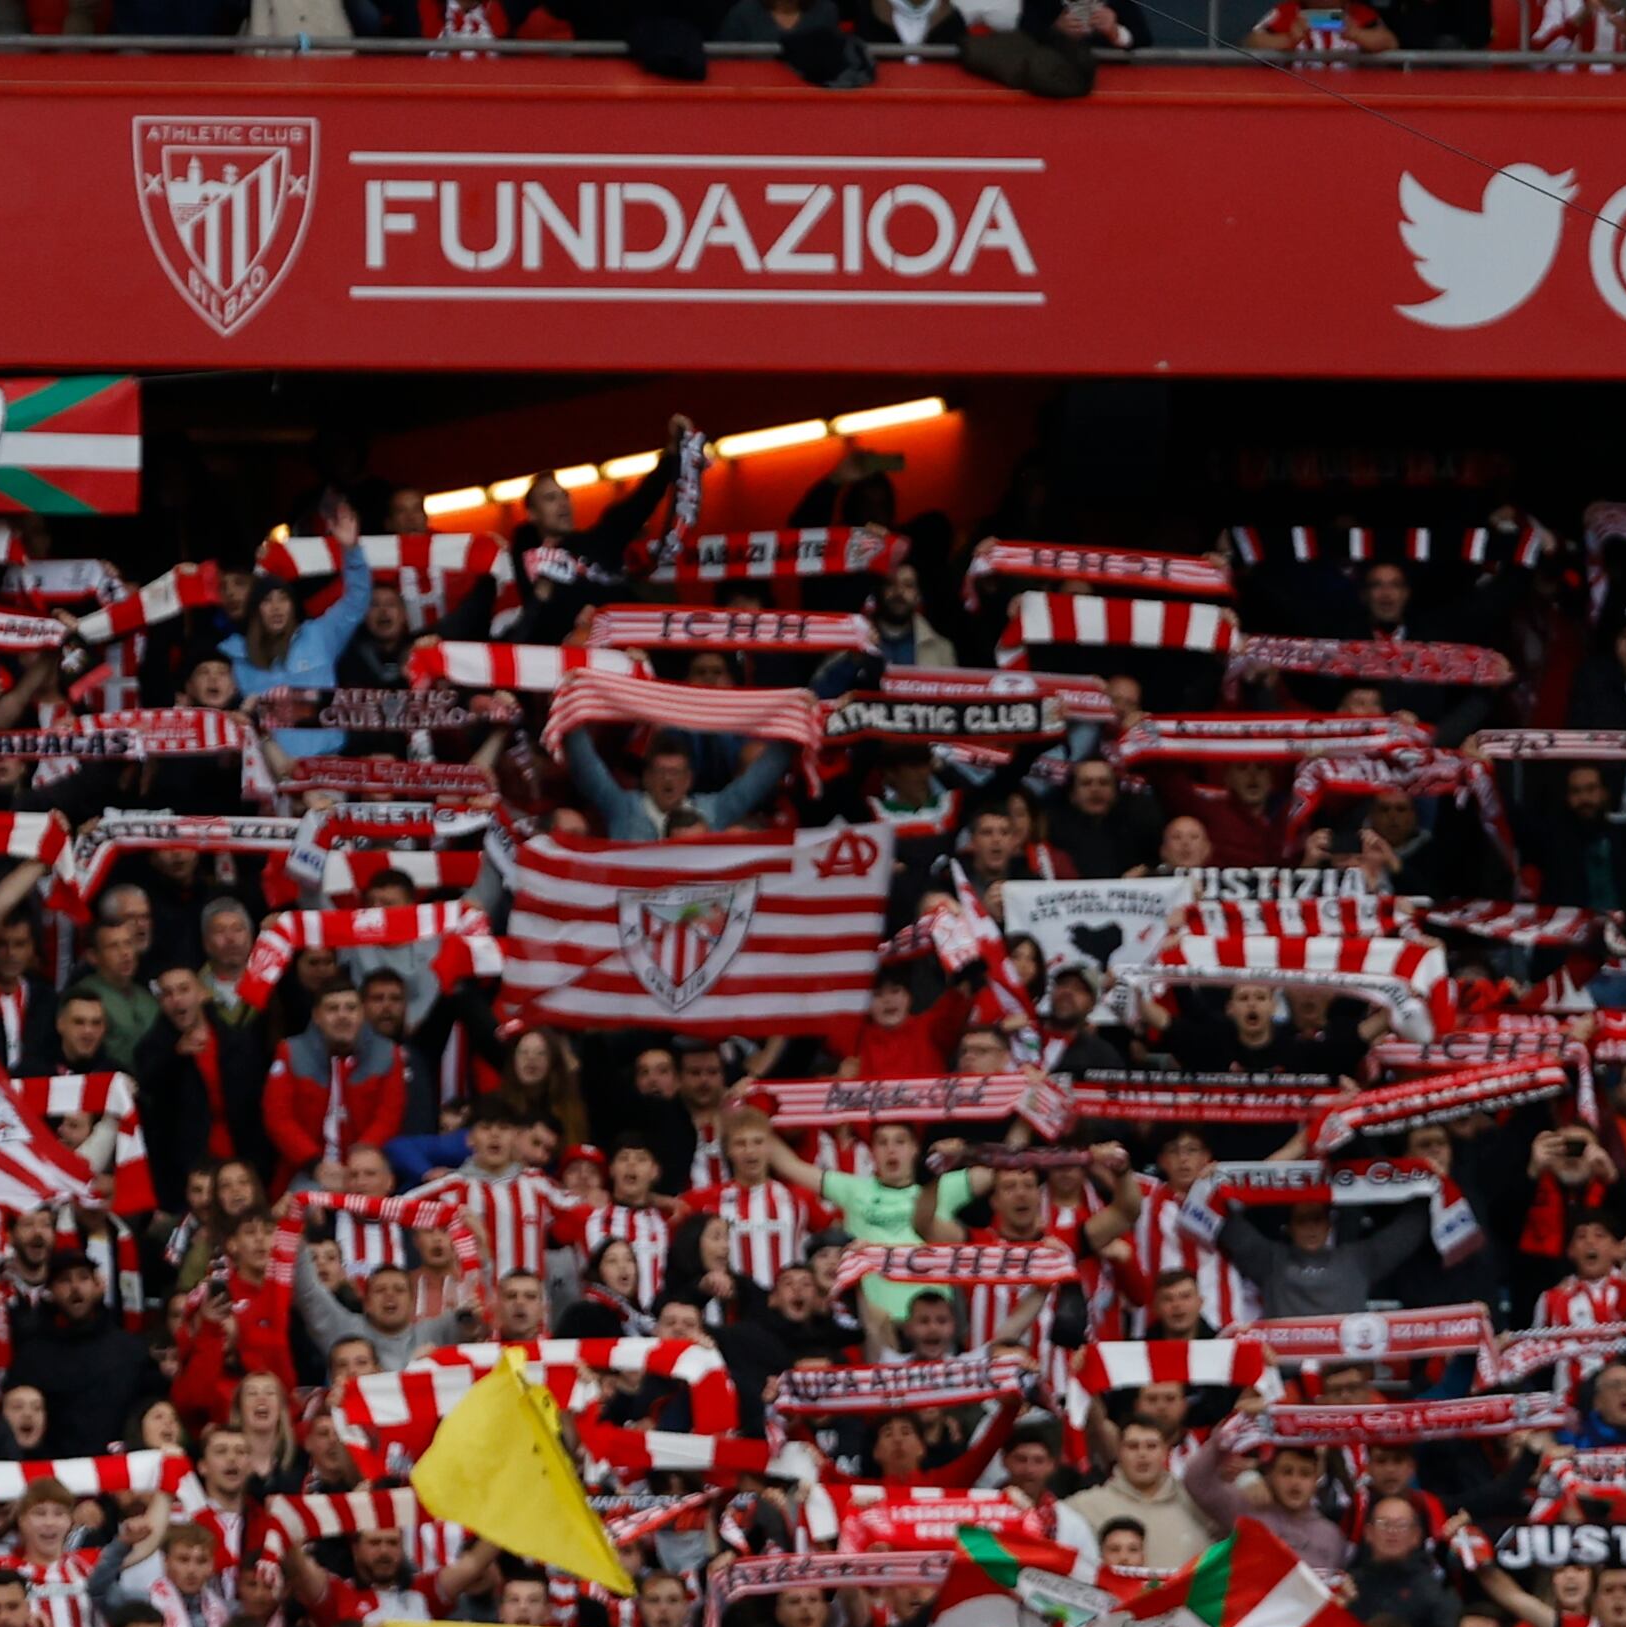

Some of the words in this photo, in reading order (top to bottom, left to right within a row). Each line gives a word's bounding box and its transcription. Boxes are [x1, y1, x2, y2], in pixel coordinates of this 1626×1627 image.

[146, 125, 242, 142] ATHLETIC
[248, 126, 304, 143] CLUB
[366, 179, 1040, 278] FUNDAZIOA
[188, 266, 268, 324] BILBAO
[656, 610, 808, 640] ICHH
[827, 702, 959, 735] ATHLETIC
[963, 702, 1038, 733] CLUB
[881, 1244, 1034, 1278] ICHH
